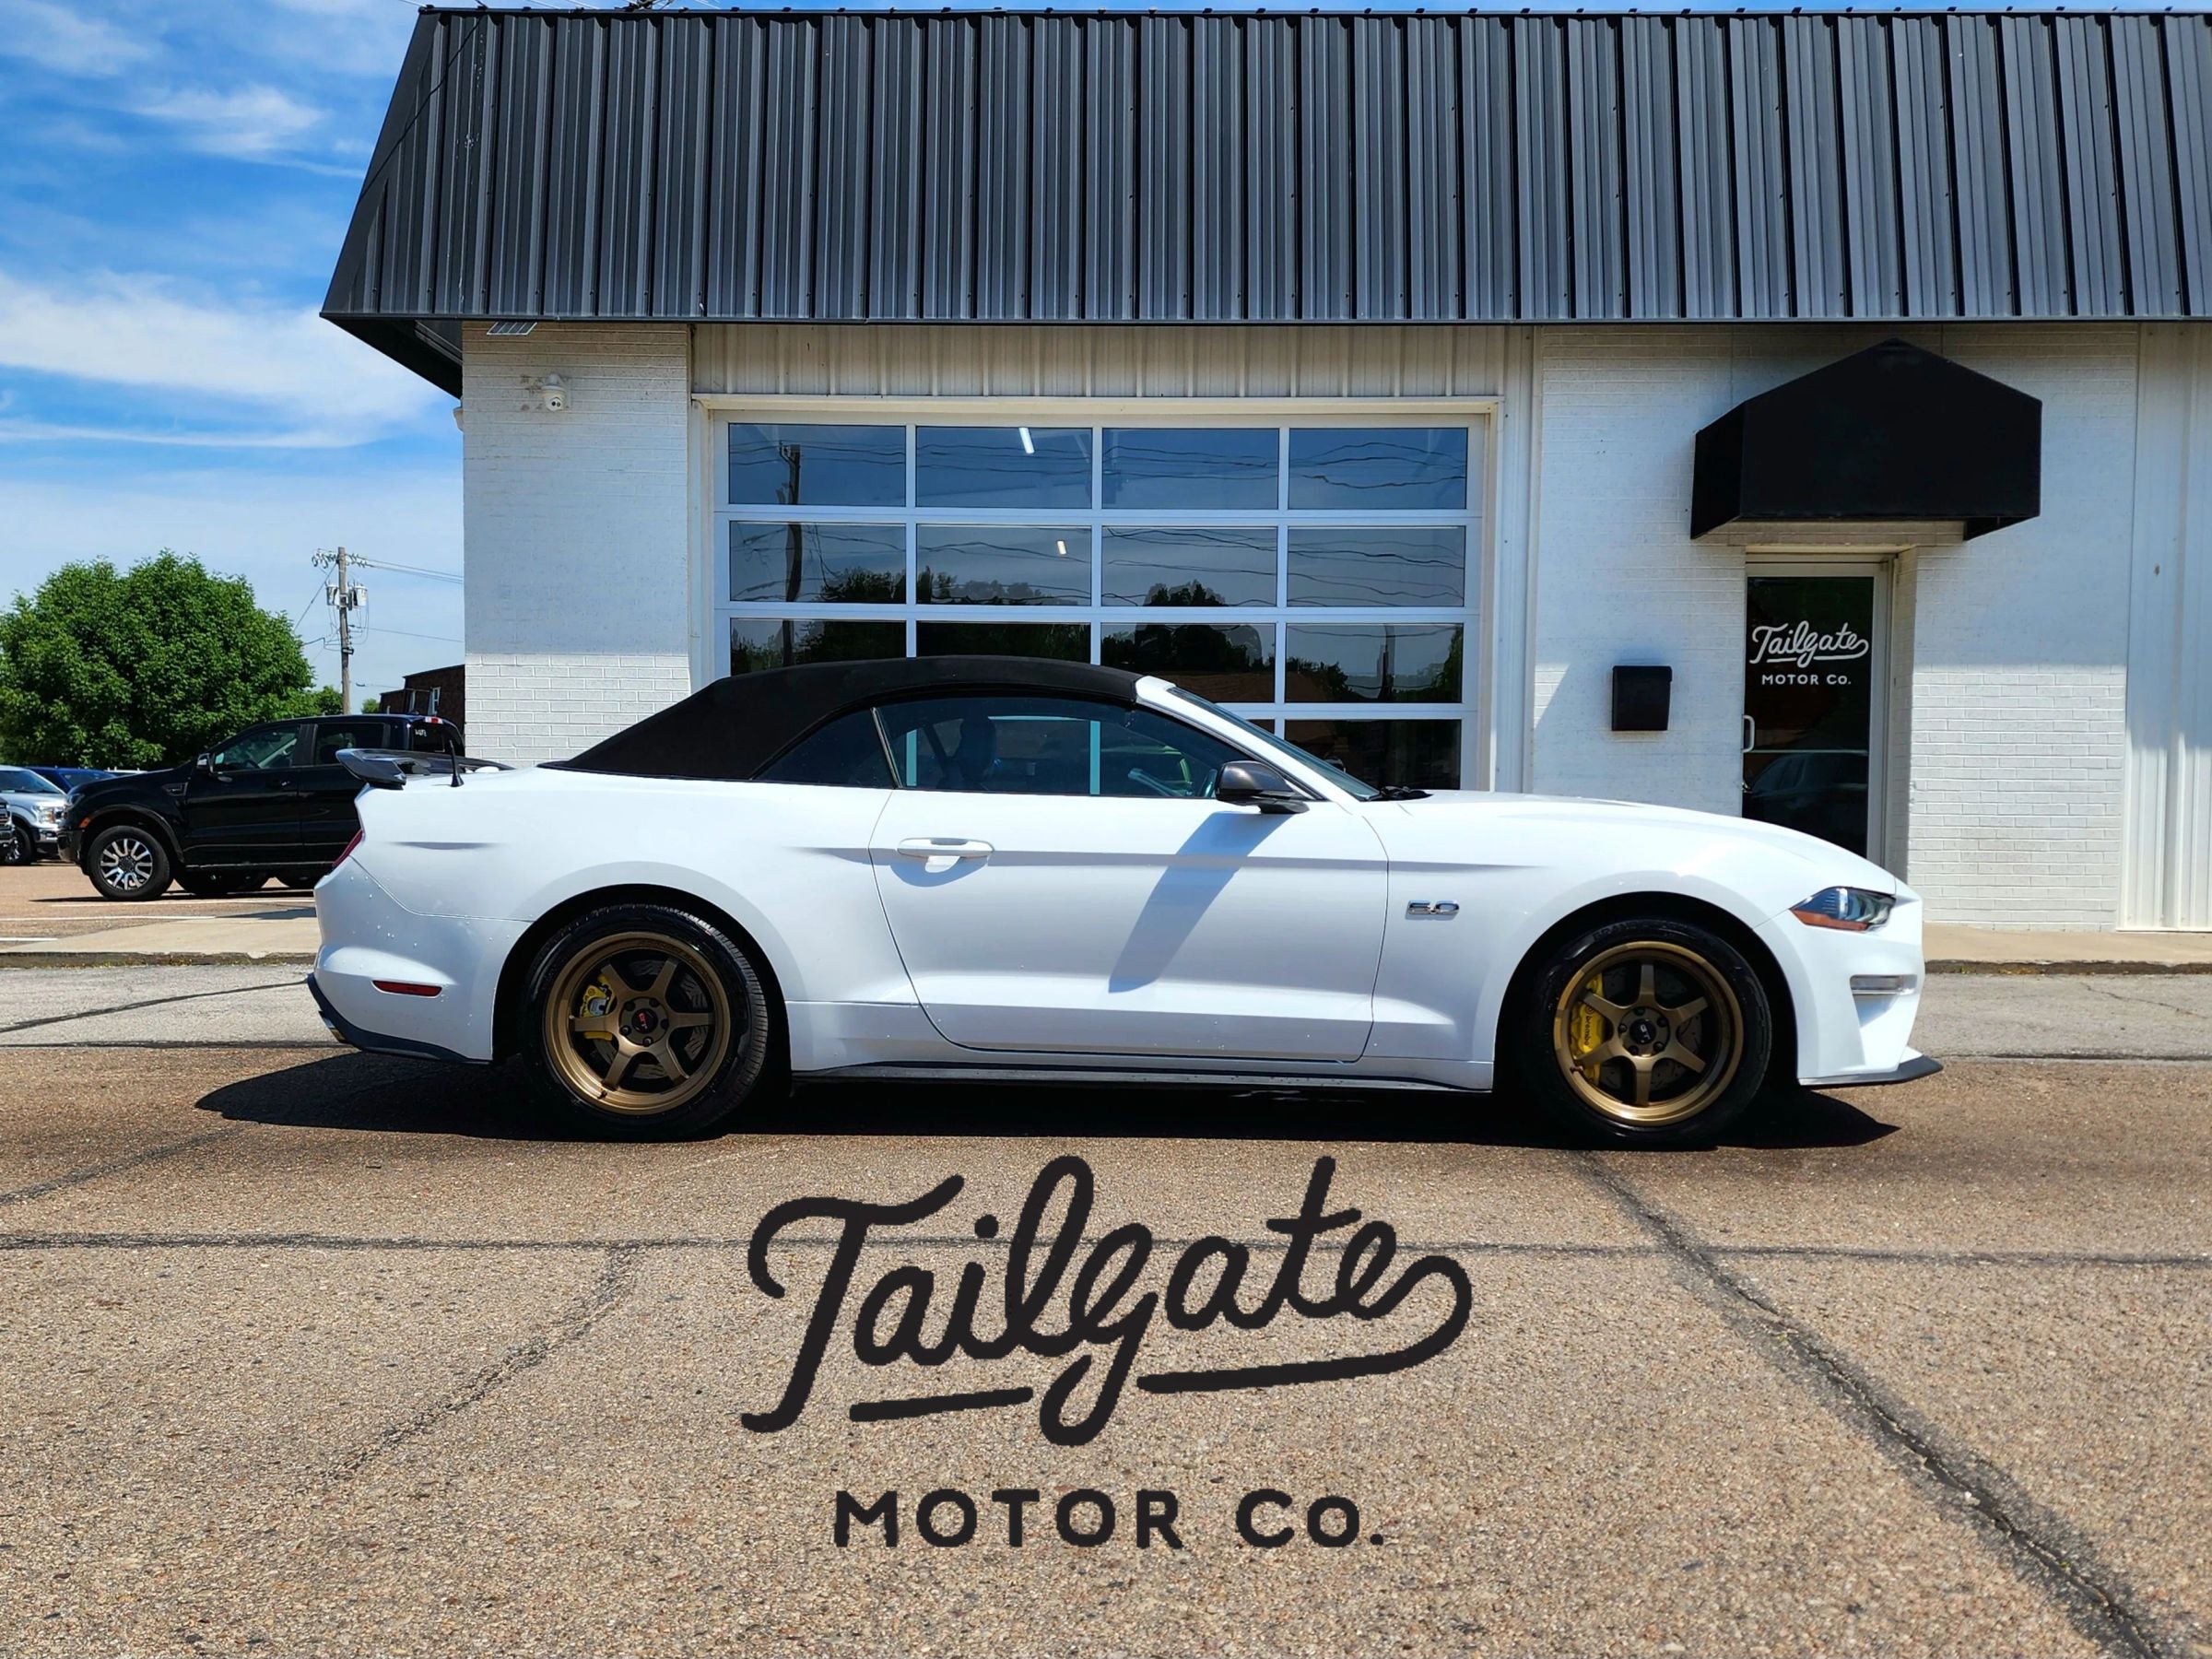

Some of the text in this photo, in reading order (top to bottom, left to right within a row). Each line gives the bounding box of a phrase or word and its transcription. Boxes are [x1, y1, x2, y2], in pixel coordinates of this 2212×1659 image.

[1748, 620, 1869, 668] Tailgate
[1761, 674, 1819, 685] MOTOR
[1407, 900, 1460, 915] 5.0
[1583, 1016, 1594, 1046] brembo
